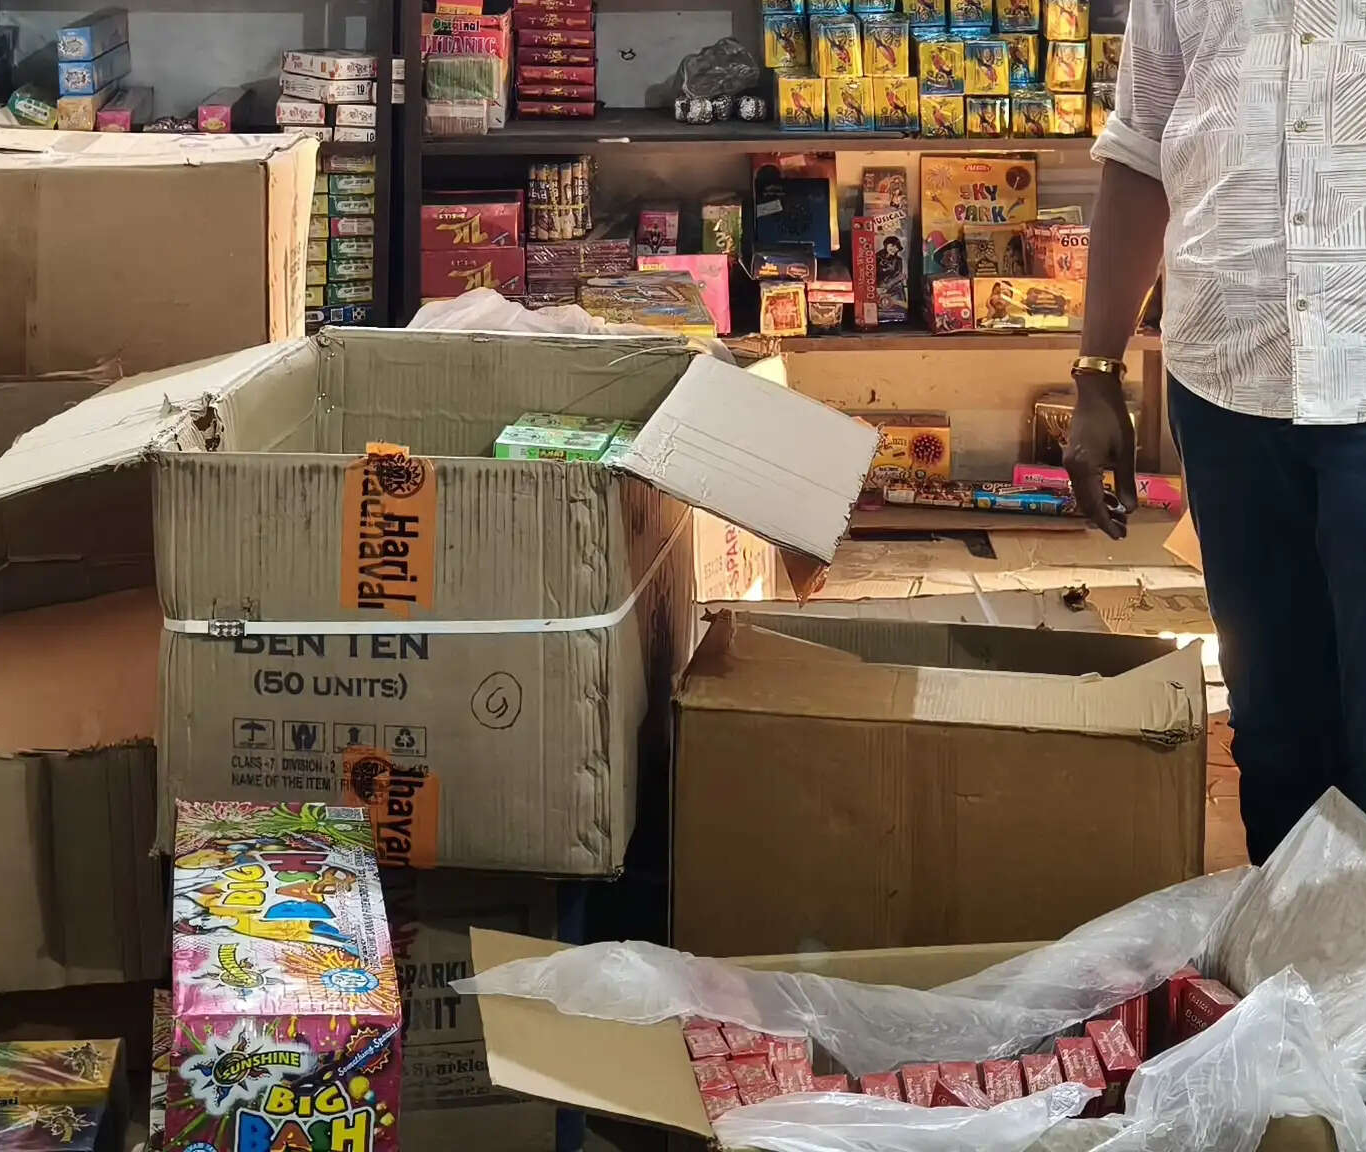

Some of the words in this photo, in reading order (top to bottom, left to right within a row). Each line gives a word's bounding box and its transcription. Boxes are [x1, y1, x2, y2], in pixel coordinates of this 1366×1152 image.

[433, 17, 481, 34] Original
[953, 204, 1007, 223] PARK
[254, 669, 305, 696] (50
[312, 672, 409, 701] UNITS)
[231, 754, 263, 771] CLASS
[282, 756, 323, 773] DIVISION
[231, 772, 261, 788] NAME
[265, 773, 278, 788] OF
[282, 774, 303, 791] THE
[305, 775, 332, 793] ITEM
[222, 863, 267, 907] BIG
[222, 1050, 302, 1080] SUNSHINE
[413, 1057, 487, 1078] Sparkle
[263, 1081, 349, 1117] BIG
